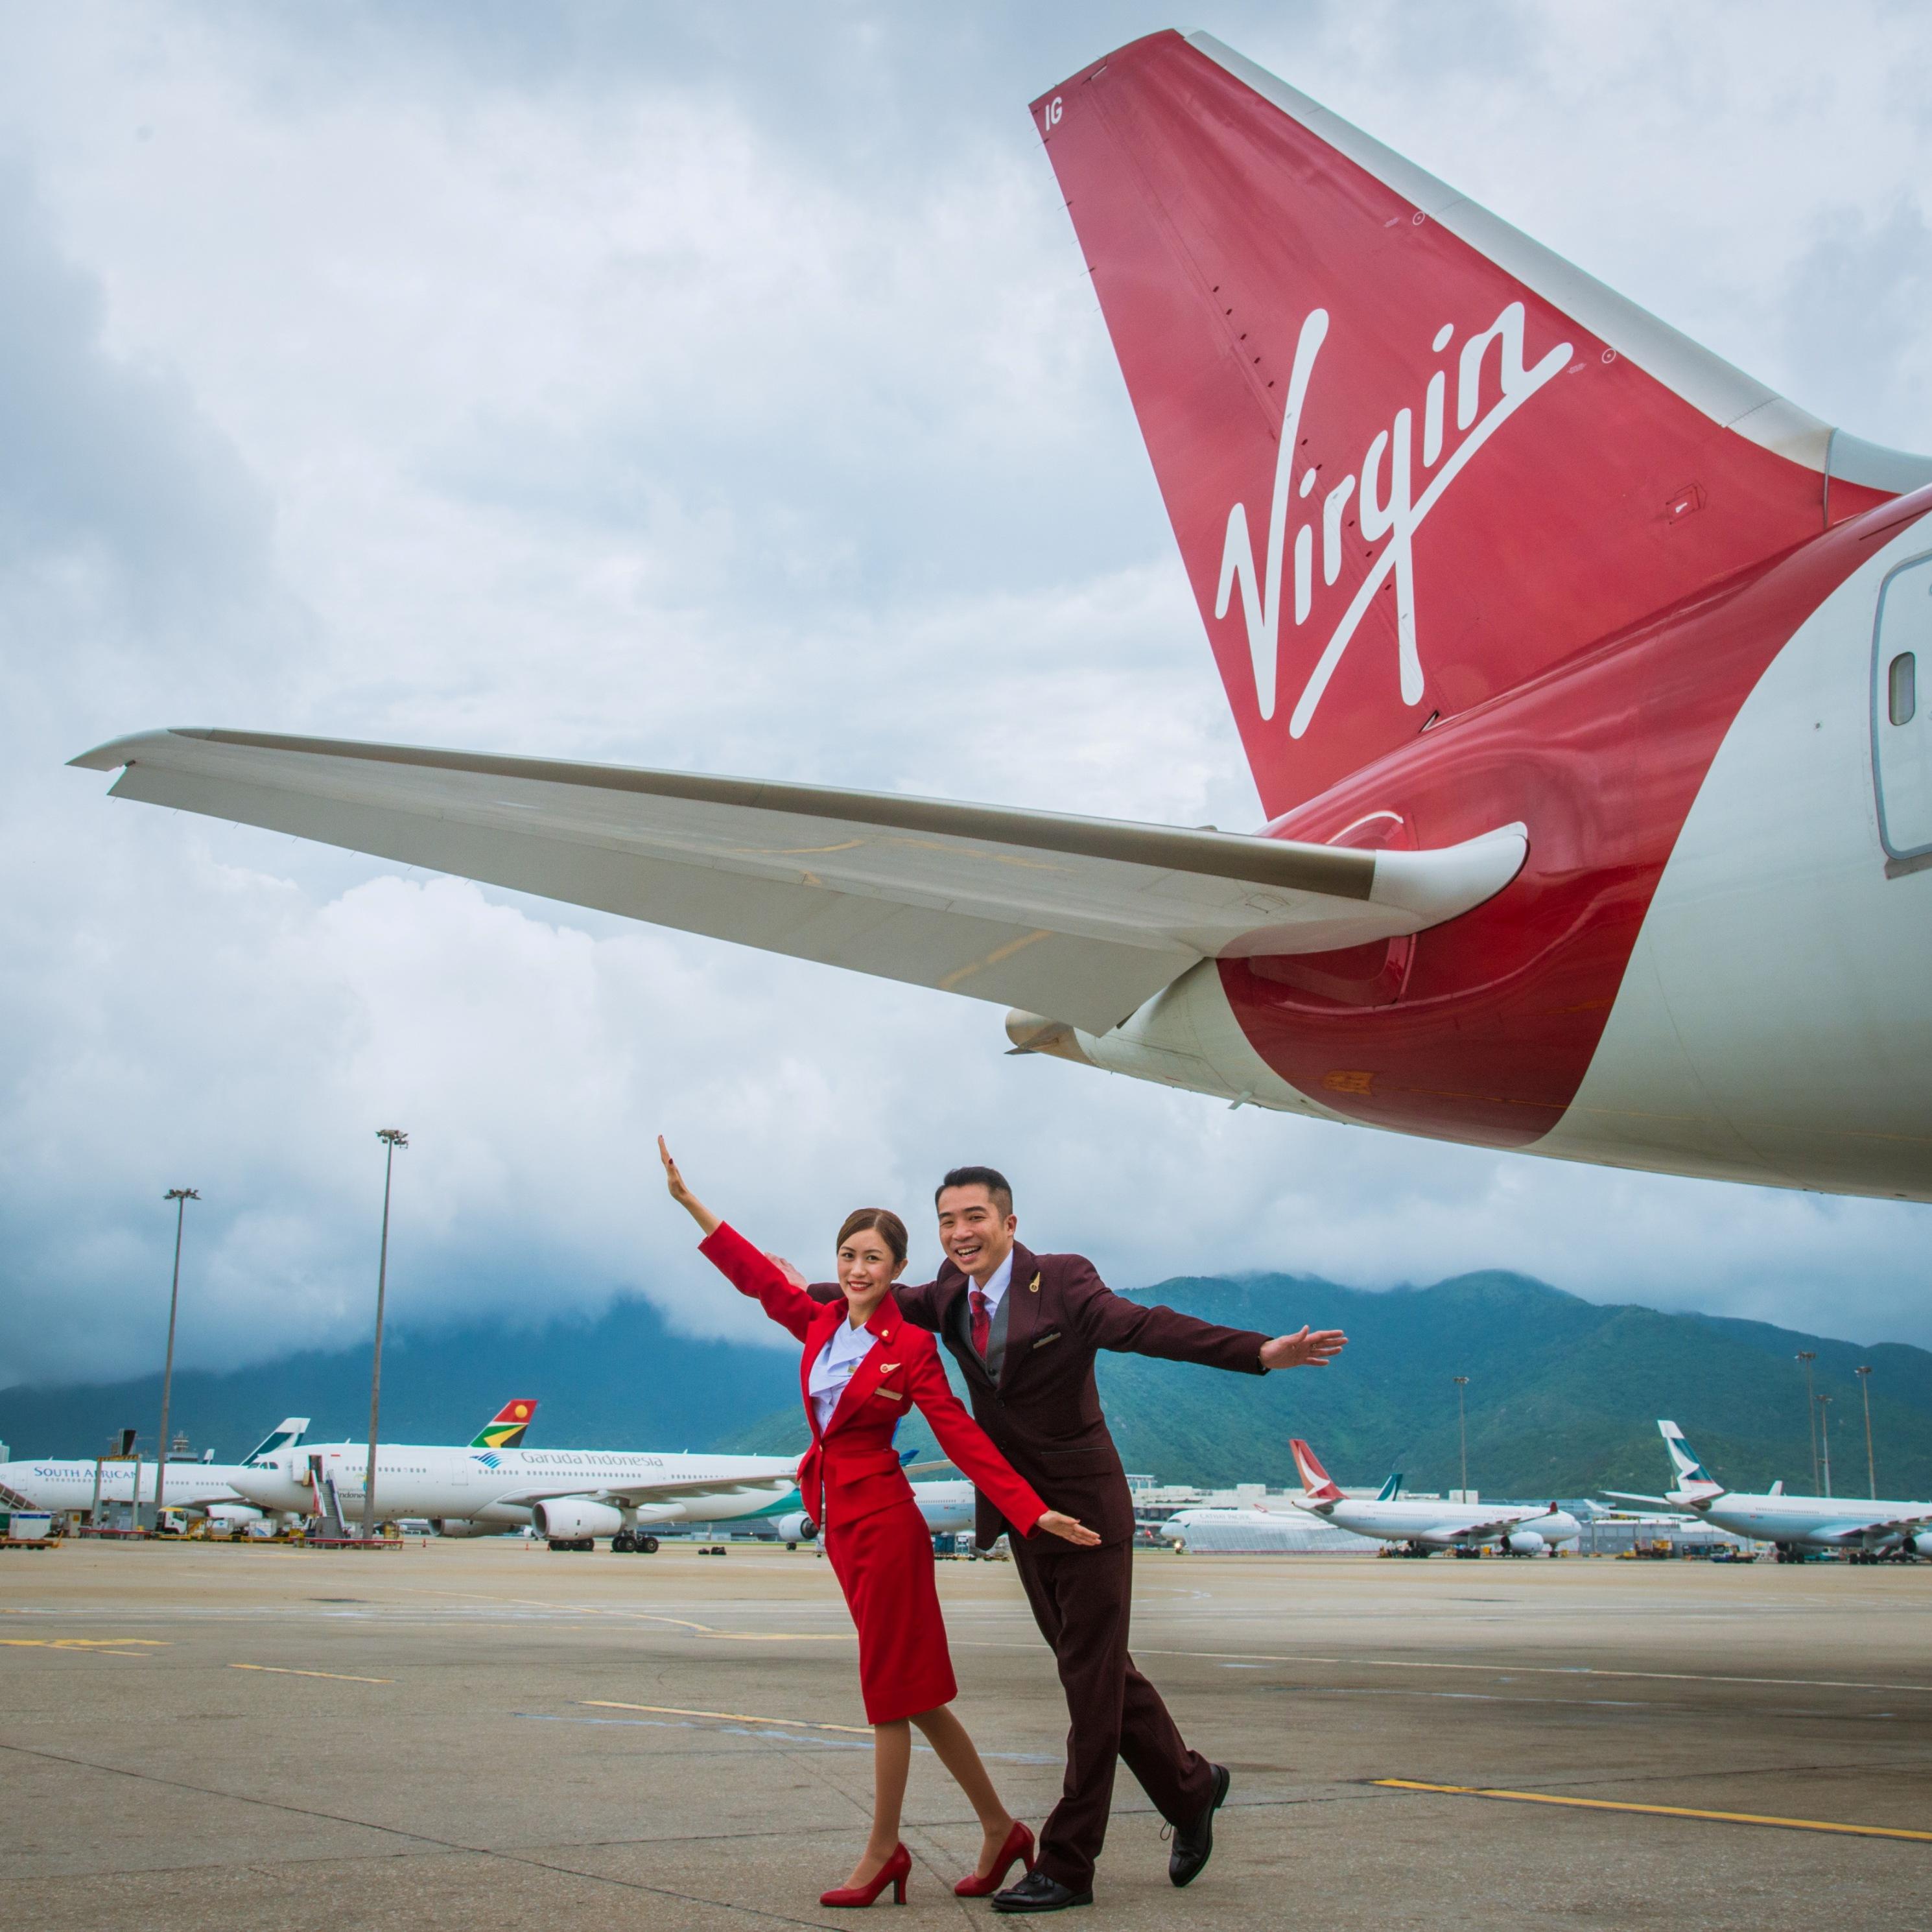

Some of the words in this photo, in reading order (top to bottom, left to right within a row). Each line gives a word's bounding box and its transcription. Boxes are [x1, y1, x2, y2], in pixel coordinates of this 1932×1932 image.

[1045, 97, 1063, 131] IG
[1215, 301, 1573, 739] Virgin
[521, 1452, 582, 1464] Garuda
[585, 1454, 663, 1467] Indonesia
[34, 1467, 80, 1477] SOUTH
